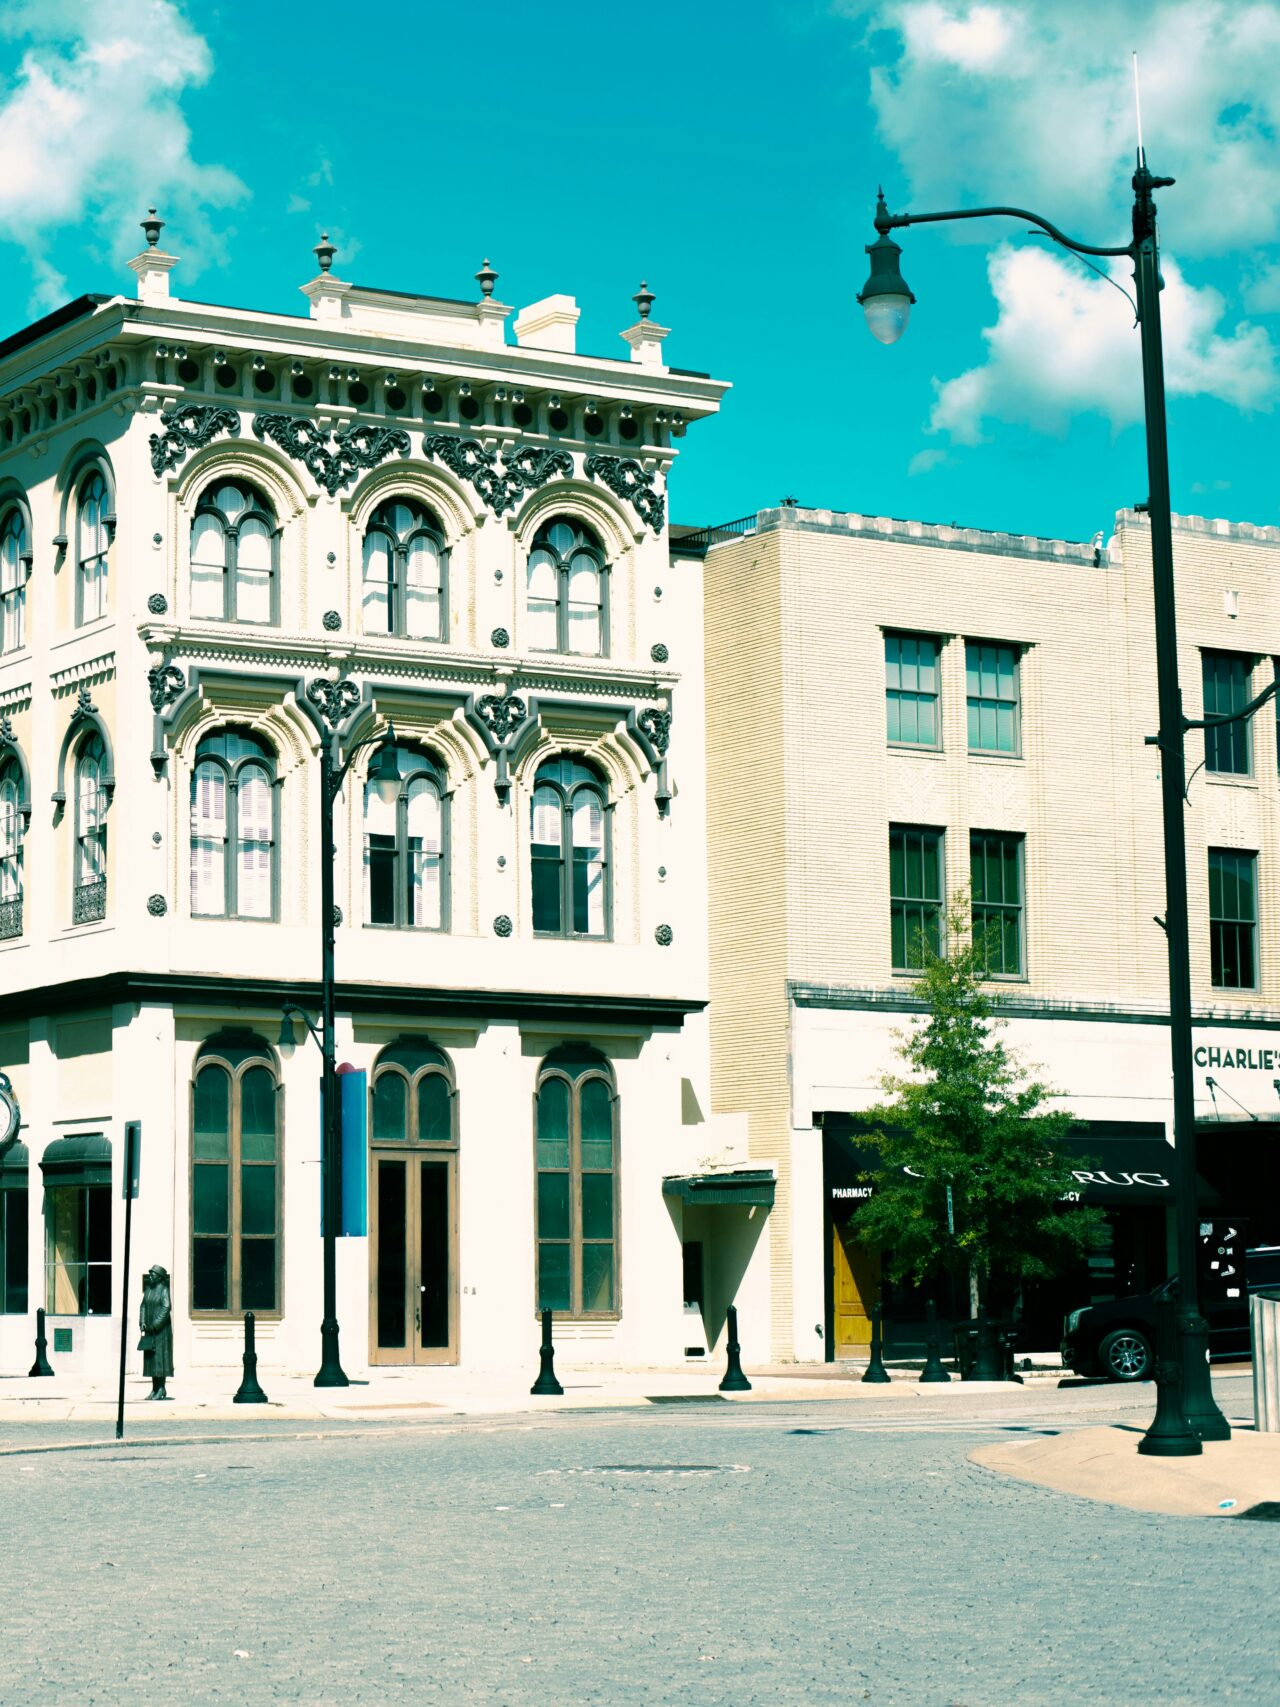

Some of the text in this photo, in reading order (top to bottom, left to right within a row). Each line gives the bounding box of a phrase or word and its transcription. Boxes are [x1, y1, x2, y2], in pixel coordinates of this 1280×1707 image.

[1194, 1046, 1280, 1070] CHARLIE'
[1041, 1170, 1170, 1187] RUG
[832, 1187, 873, 1198] PHARMACY
